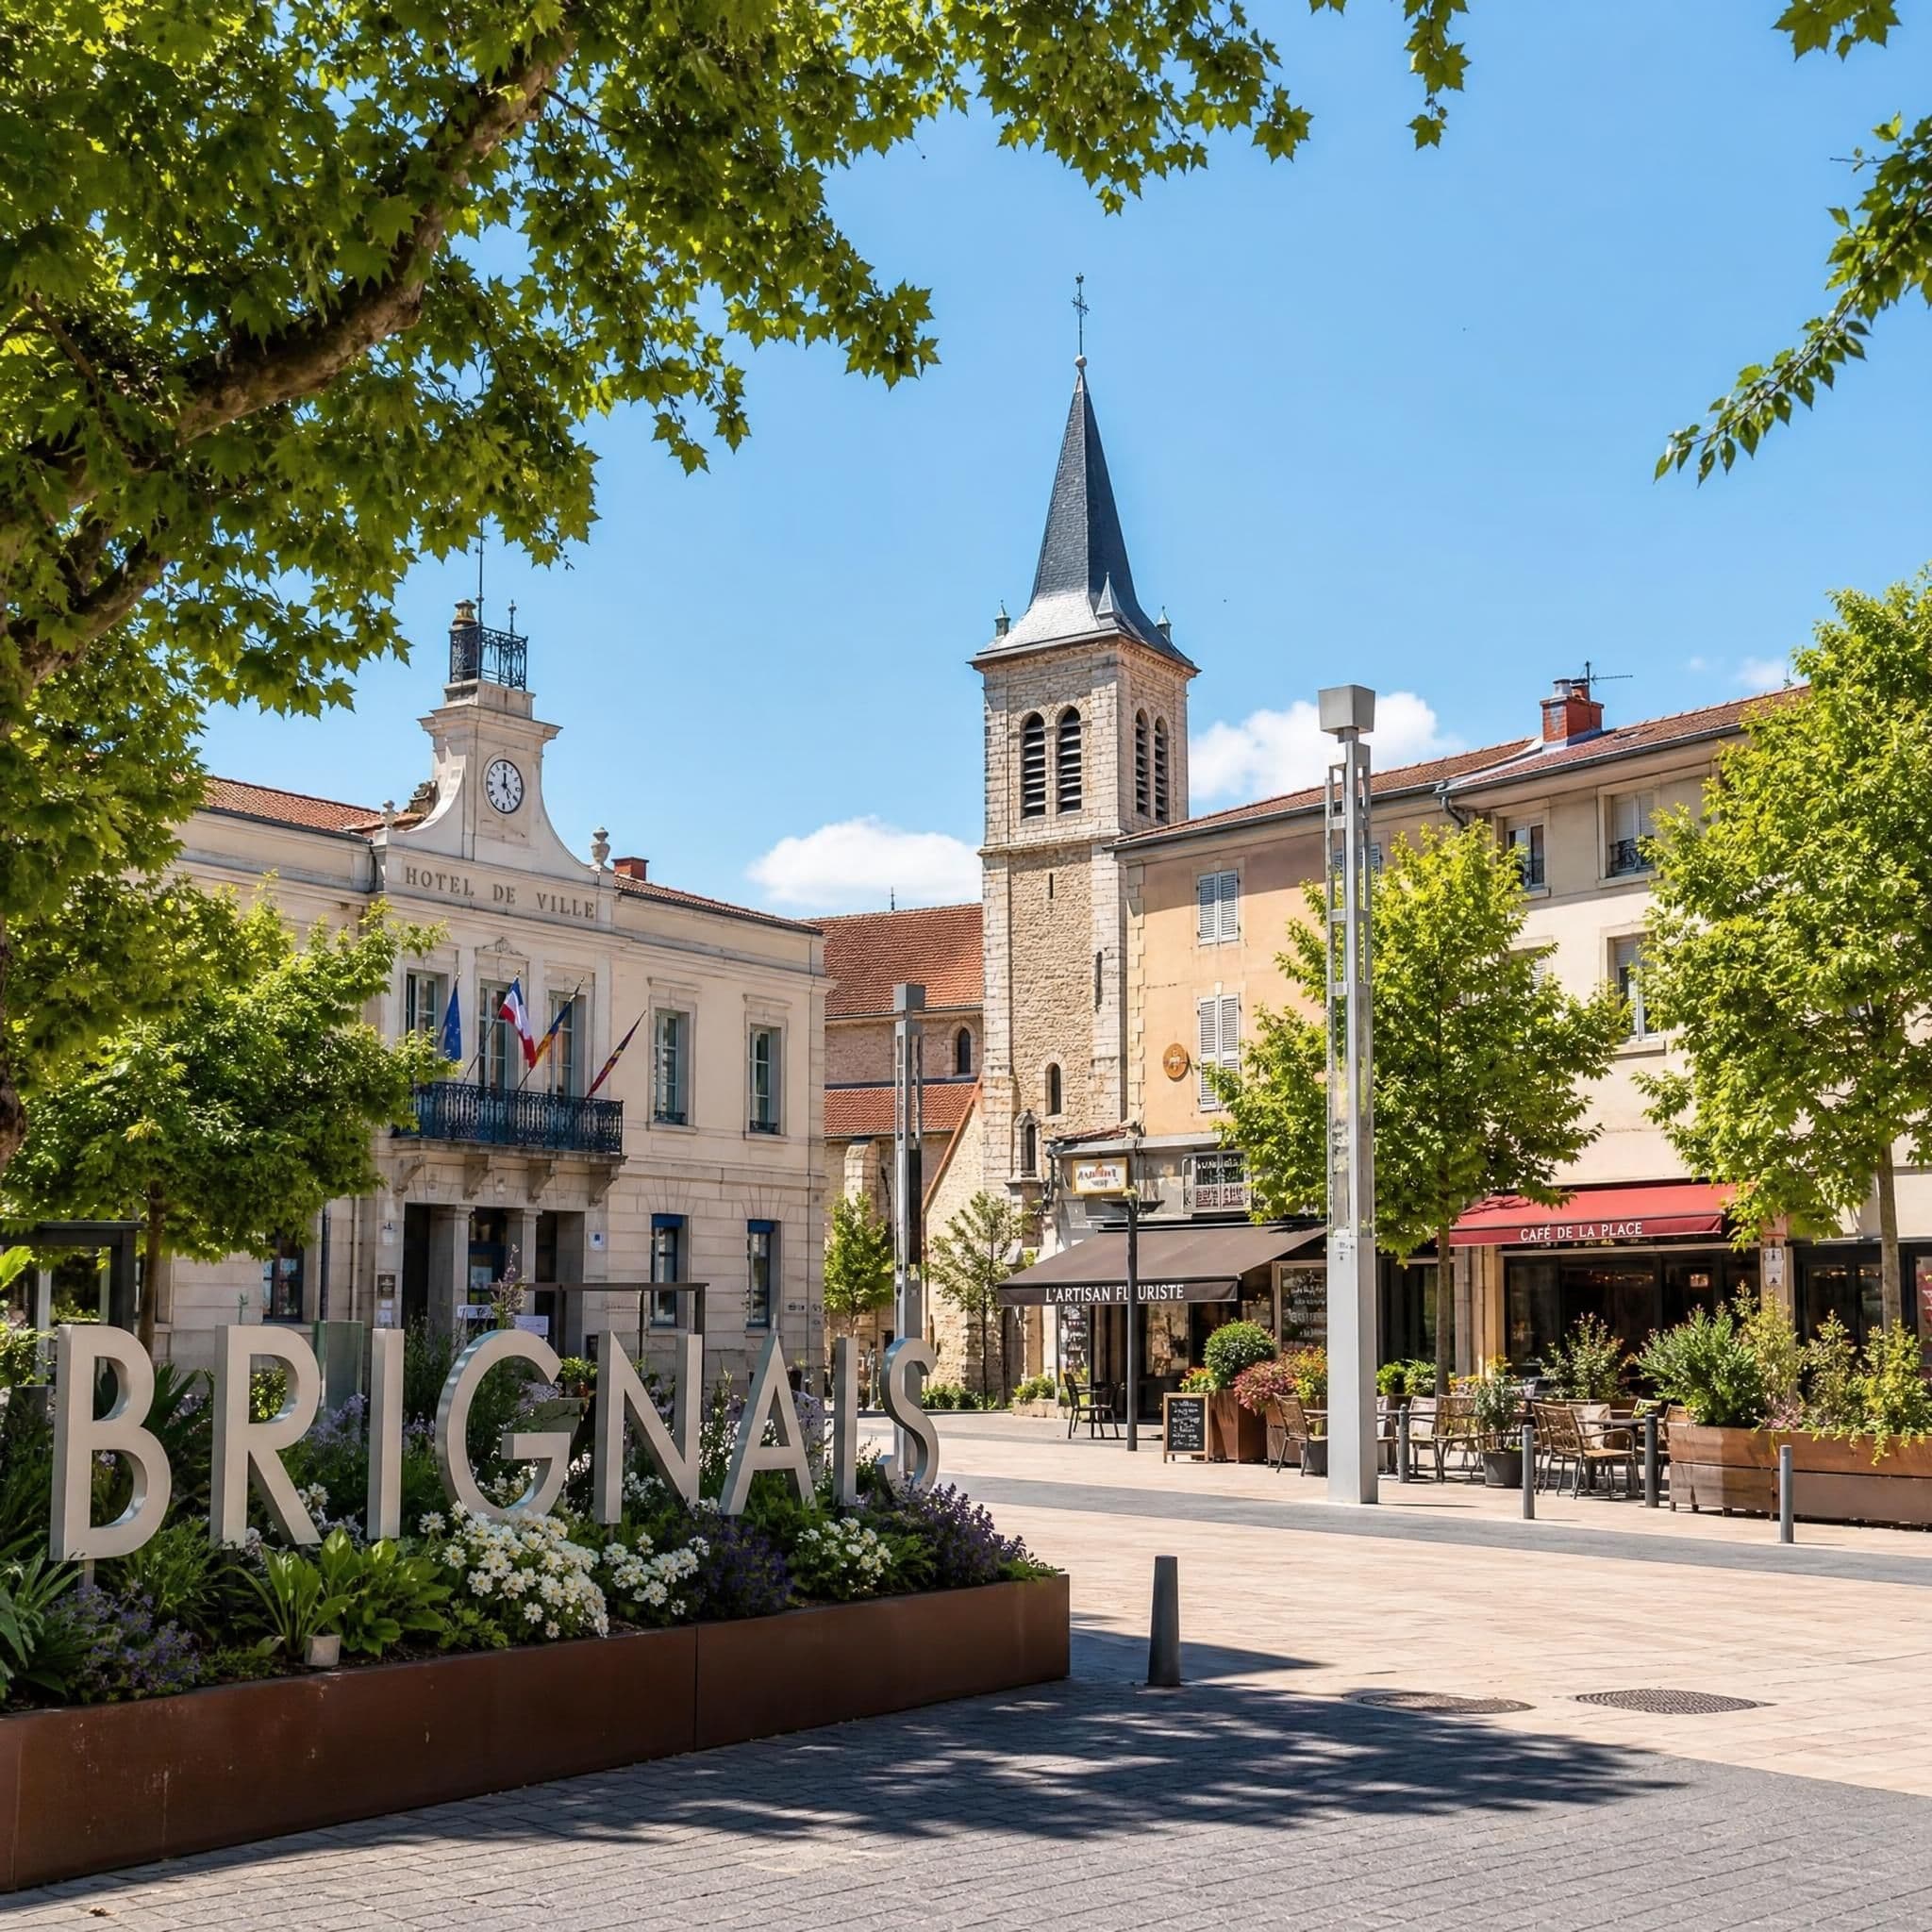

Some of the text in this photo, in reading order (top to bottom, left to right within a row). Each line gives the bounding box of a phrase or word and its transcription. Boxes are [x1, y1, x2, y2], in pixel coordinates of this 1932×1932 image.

[406, 867, 594, 919] HOTEL DE VILLE
[1520, 1222, 1642, 1241] CAFÉ DE LA PLACE
[1045, 1284, 1184, 1303] L'ARTISAN FLURISTE
[50, 1324, 941, 1561] BRIGNAIS
